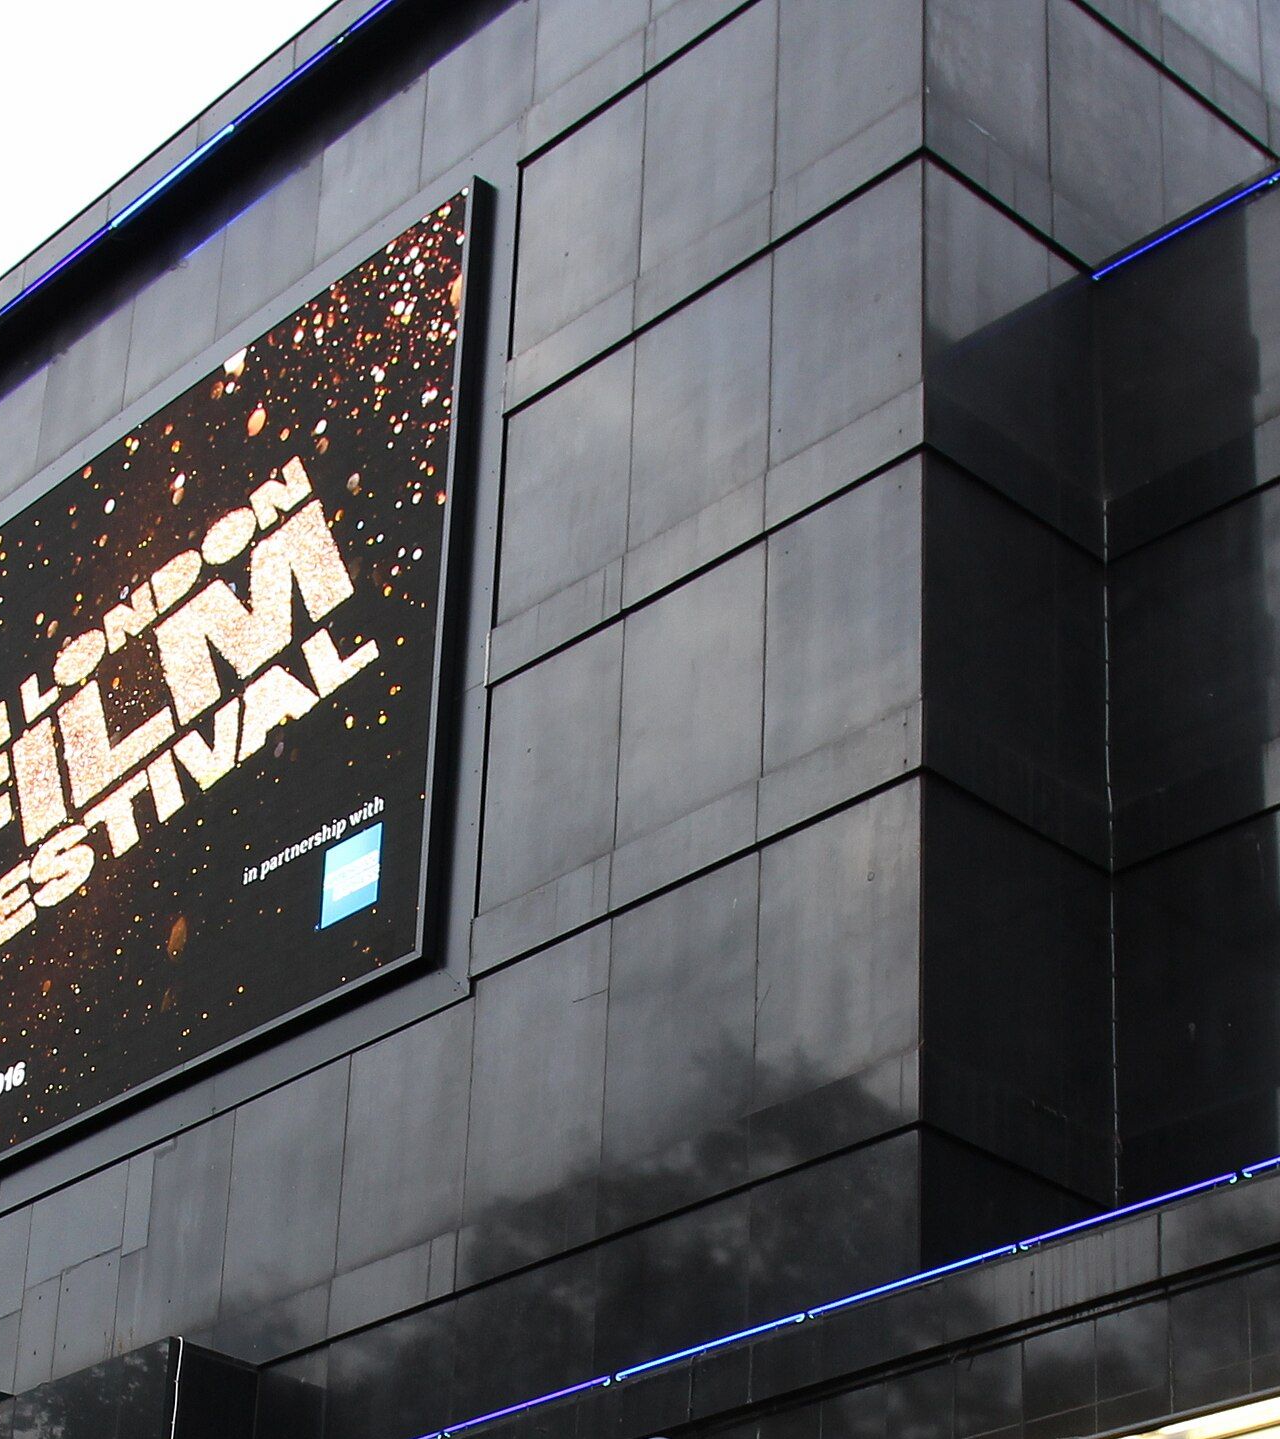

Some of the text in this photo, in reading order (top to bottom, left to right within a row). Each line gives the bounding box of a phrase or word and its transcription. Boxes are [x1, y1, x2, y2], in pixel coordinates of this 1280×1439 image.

[20, 454, 313, 724] LONDON
[242, 866, 258, 885] in
[259, 818, 347, 880] partnership
[348, 796, 385, 827] with
